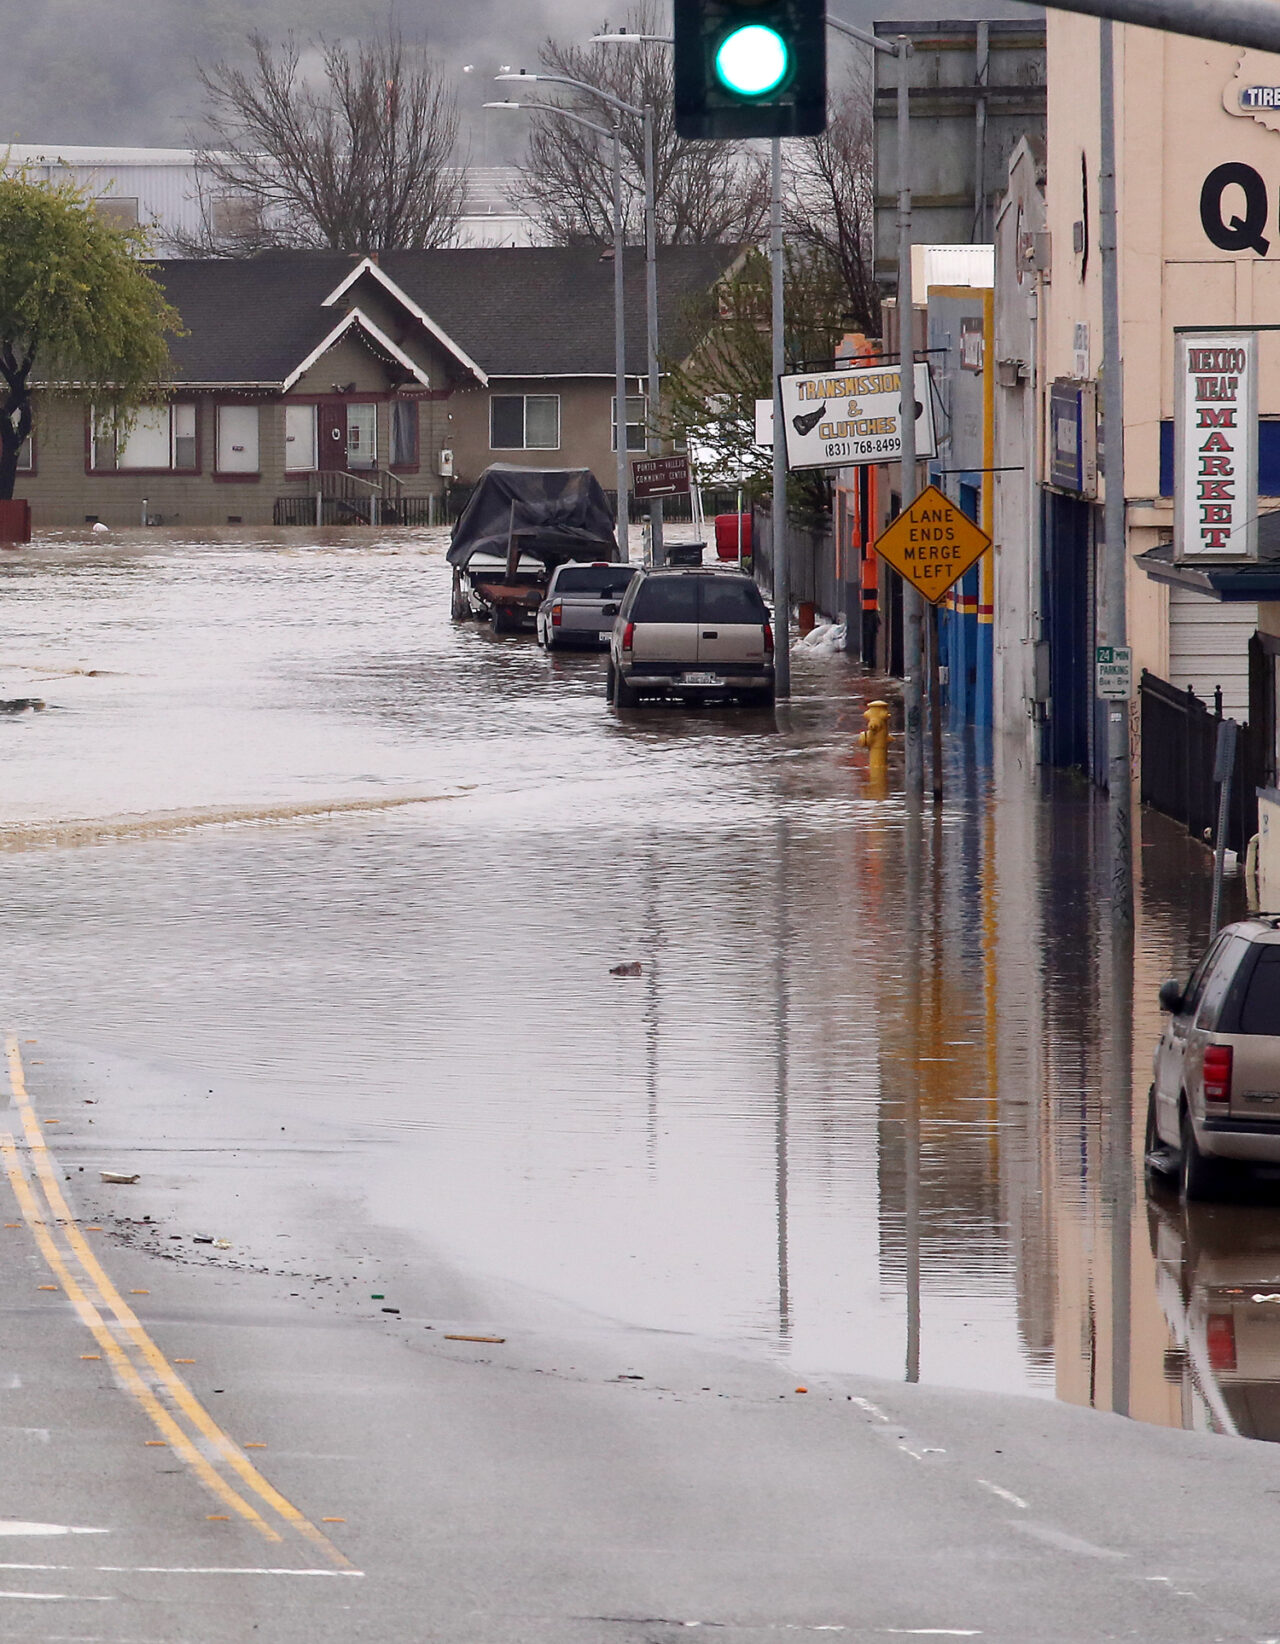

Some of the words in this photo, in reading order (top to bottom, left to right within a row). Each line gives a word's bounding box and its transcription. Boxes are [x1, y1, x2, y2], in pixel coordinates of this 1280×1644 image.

[1200, 162, 1280, 257] Q
[1188, 348, 1246, 374] MEXICO
[1195, 377, 1238, 401] MEAT
[847, 400, 863, 418] &
[820, 417, 896, 440] CLUTCHES
[825, 443, 851, 457] (831)
[853, 438, 901, 455] 768-8499
[636, 473, 665, 484] COMMUNITY
[669, 470, 687, 480] CENTER
[1196, 408, 1237, 547] MARKET
[910, 509, 954, 523] LANE
[910, 528, 955, 541] ENDS
[904, 546, 961, 560] MERGE
[913, 564, 953, 579] LEFT
[1099, 650, 1110, 661] 24
[1114, 651, 1129, 661] MIN
[1100, 665, 1128, 675] PARKING
